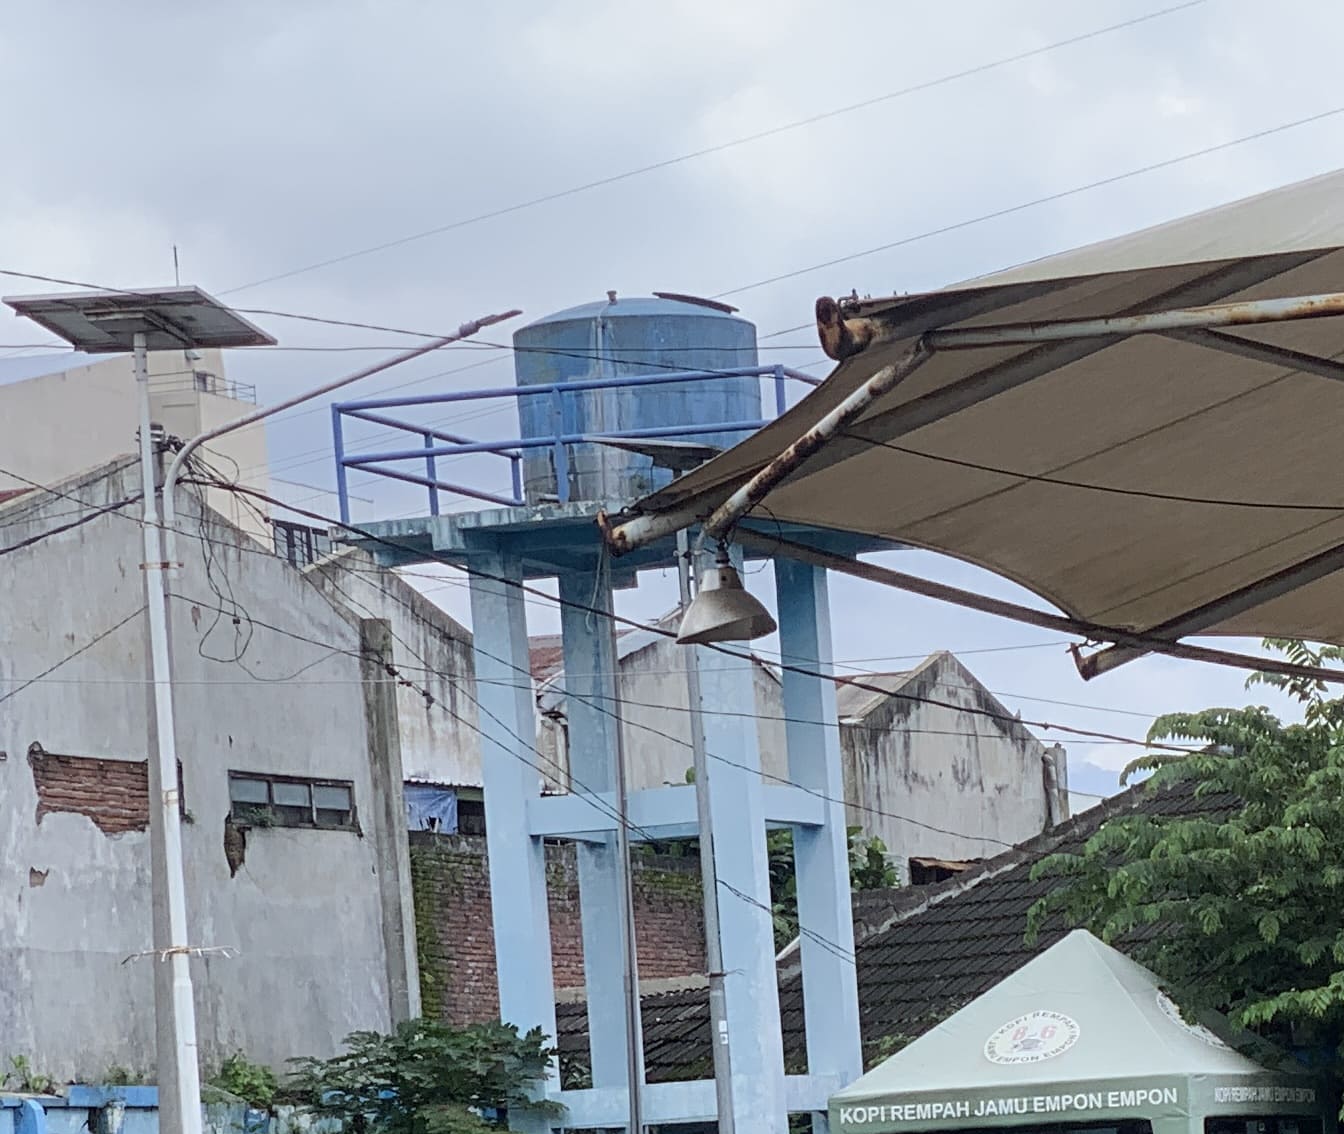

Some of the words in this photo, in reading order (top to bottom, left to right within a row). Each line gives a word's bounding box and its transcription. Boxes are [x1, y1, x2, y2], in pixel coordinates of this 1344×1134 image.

[840, 1106, 885, 1125] KOPI
[891, 1101, 970, 1122] REMPAH
[974, 1098, 1028, 1118] JAMU
[1033, 1093, 1102, 1113] EMPON
[1108, 1088, 1177, 1108] EMPON
